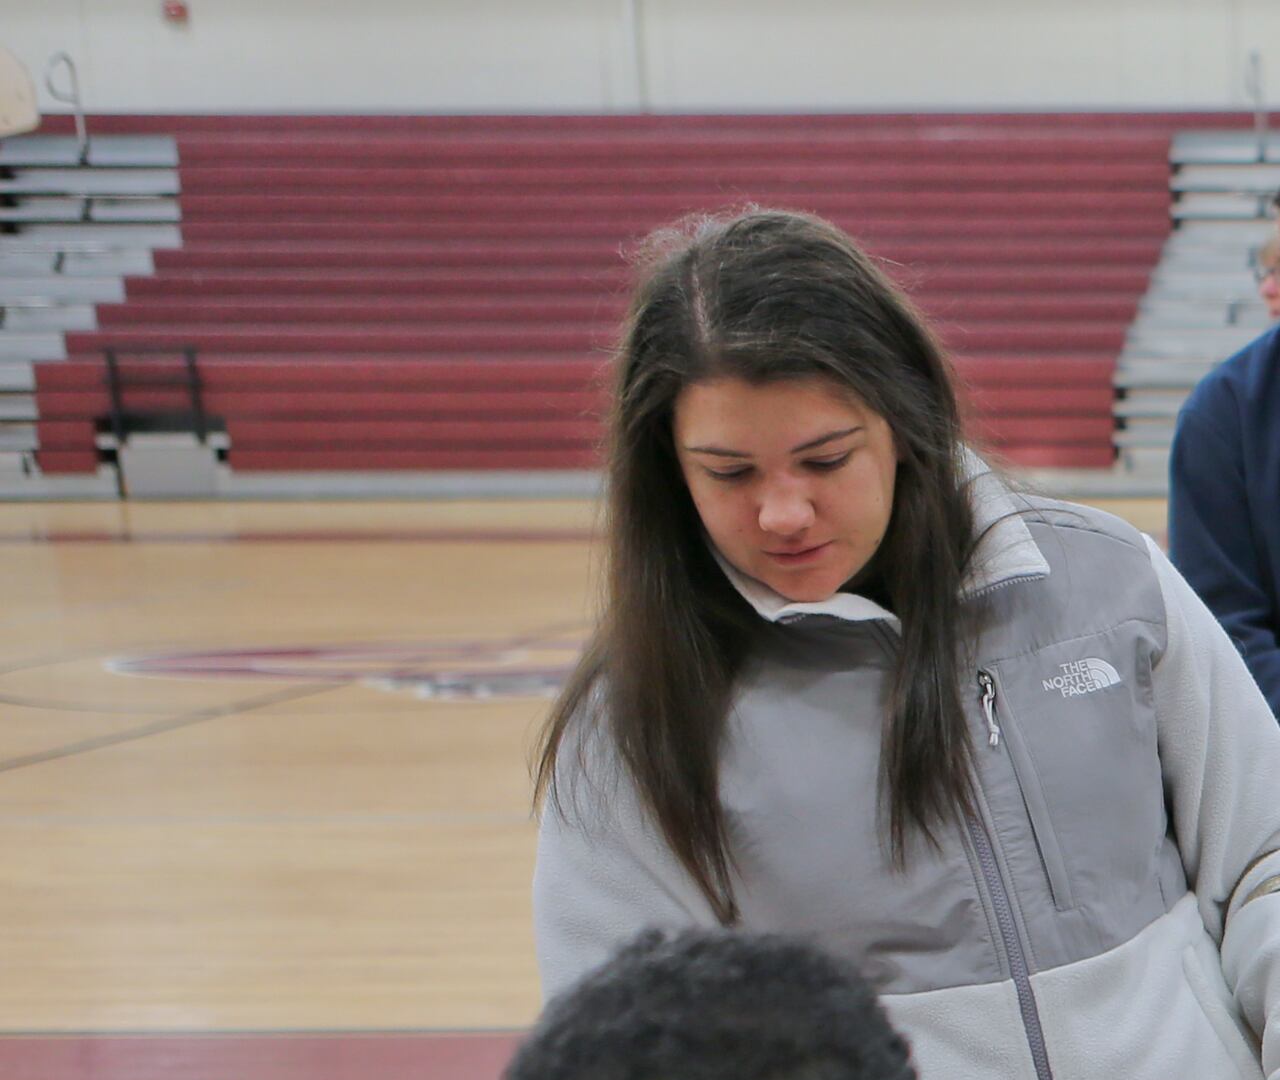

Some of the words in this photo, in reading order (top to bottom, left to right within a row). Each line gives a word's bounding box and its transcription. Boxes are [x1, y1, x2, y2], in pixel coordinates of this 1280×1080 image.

[1059, 660, 1089, 674] THE
[1042, 671, 1092, 691] NORTH
[1061, 681, 1097, 698] FACE
